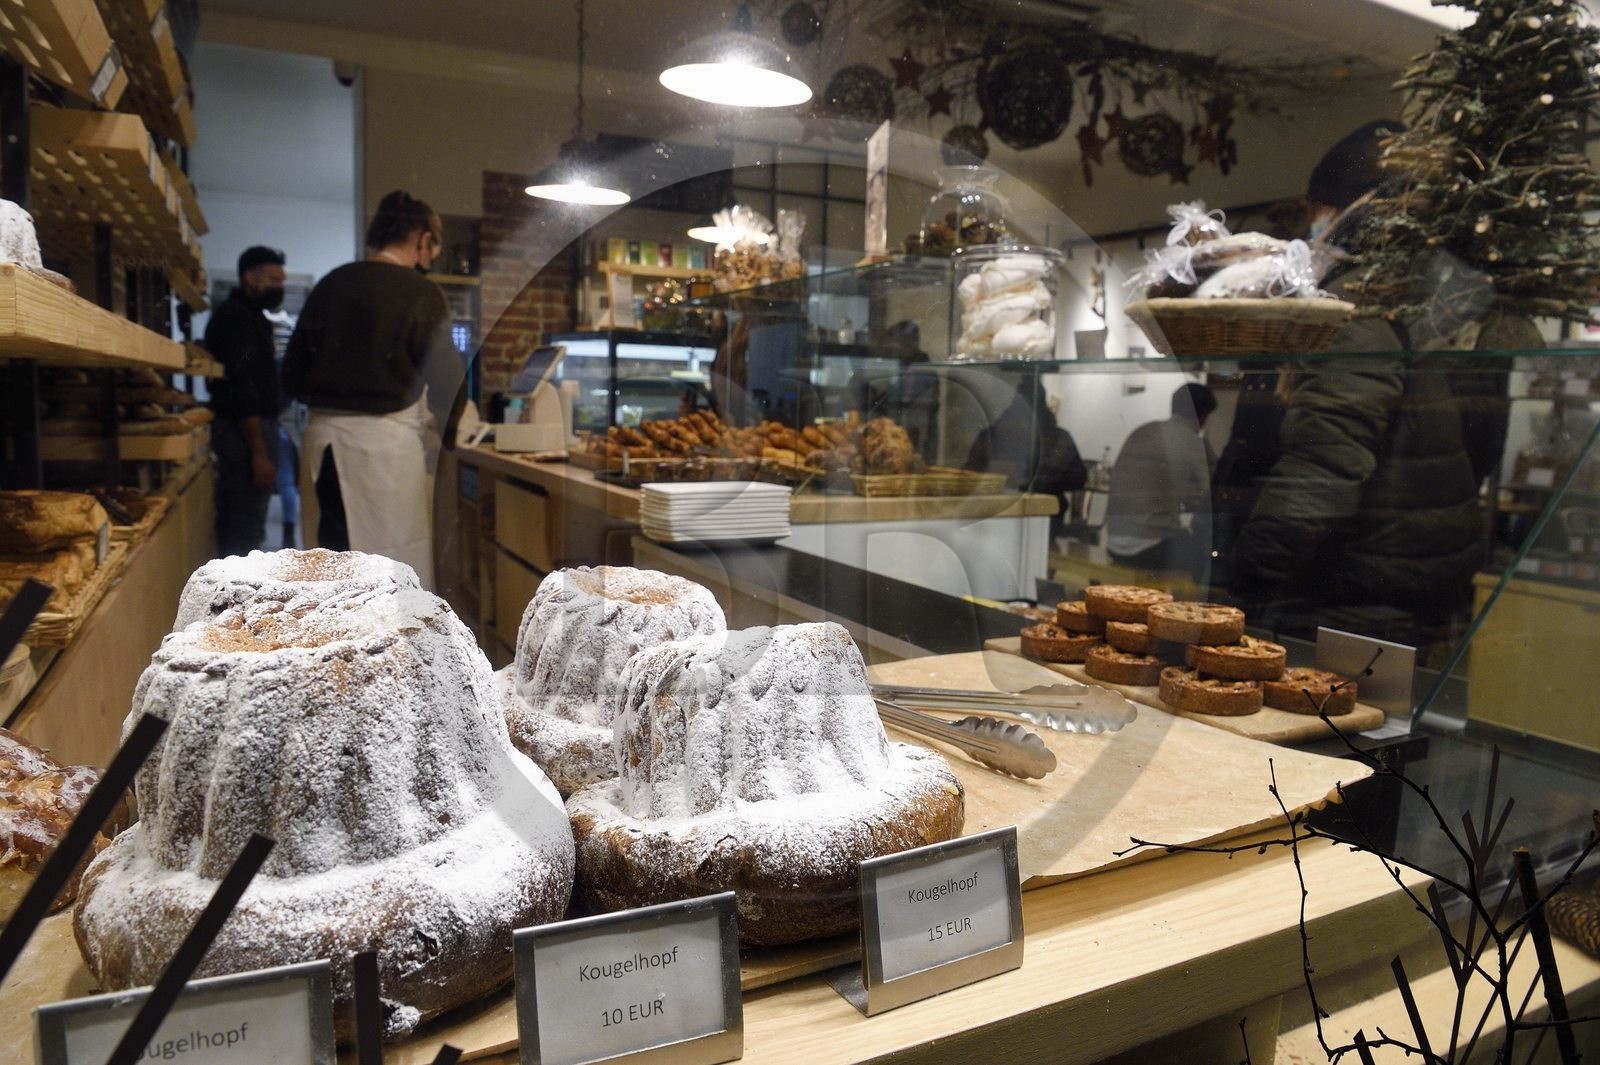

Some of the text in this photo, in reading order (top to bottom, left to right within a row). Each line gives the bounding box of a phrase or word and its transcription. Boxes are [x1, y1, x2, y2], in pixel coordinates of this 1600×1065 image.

[908, 871, 979, 904] Kougelhopf
[927, 917, 972, 942] 15 EUR
[579, 945, 679, 982] Kougelhopf
[601, 999, 664, 1027] 10 EUR
[137, 1022, 249, 1060] ugelhopf
